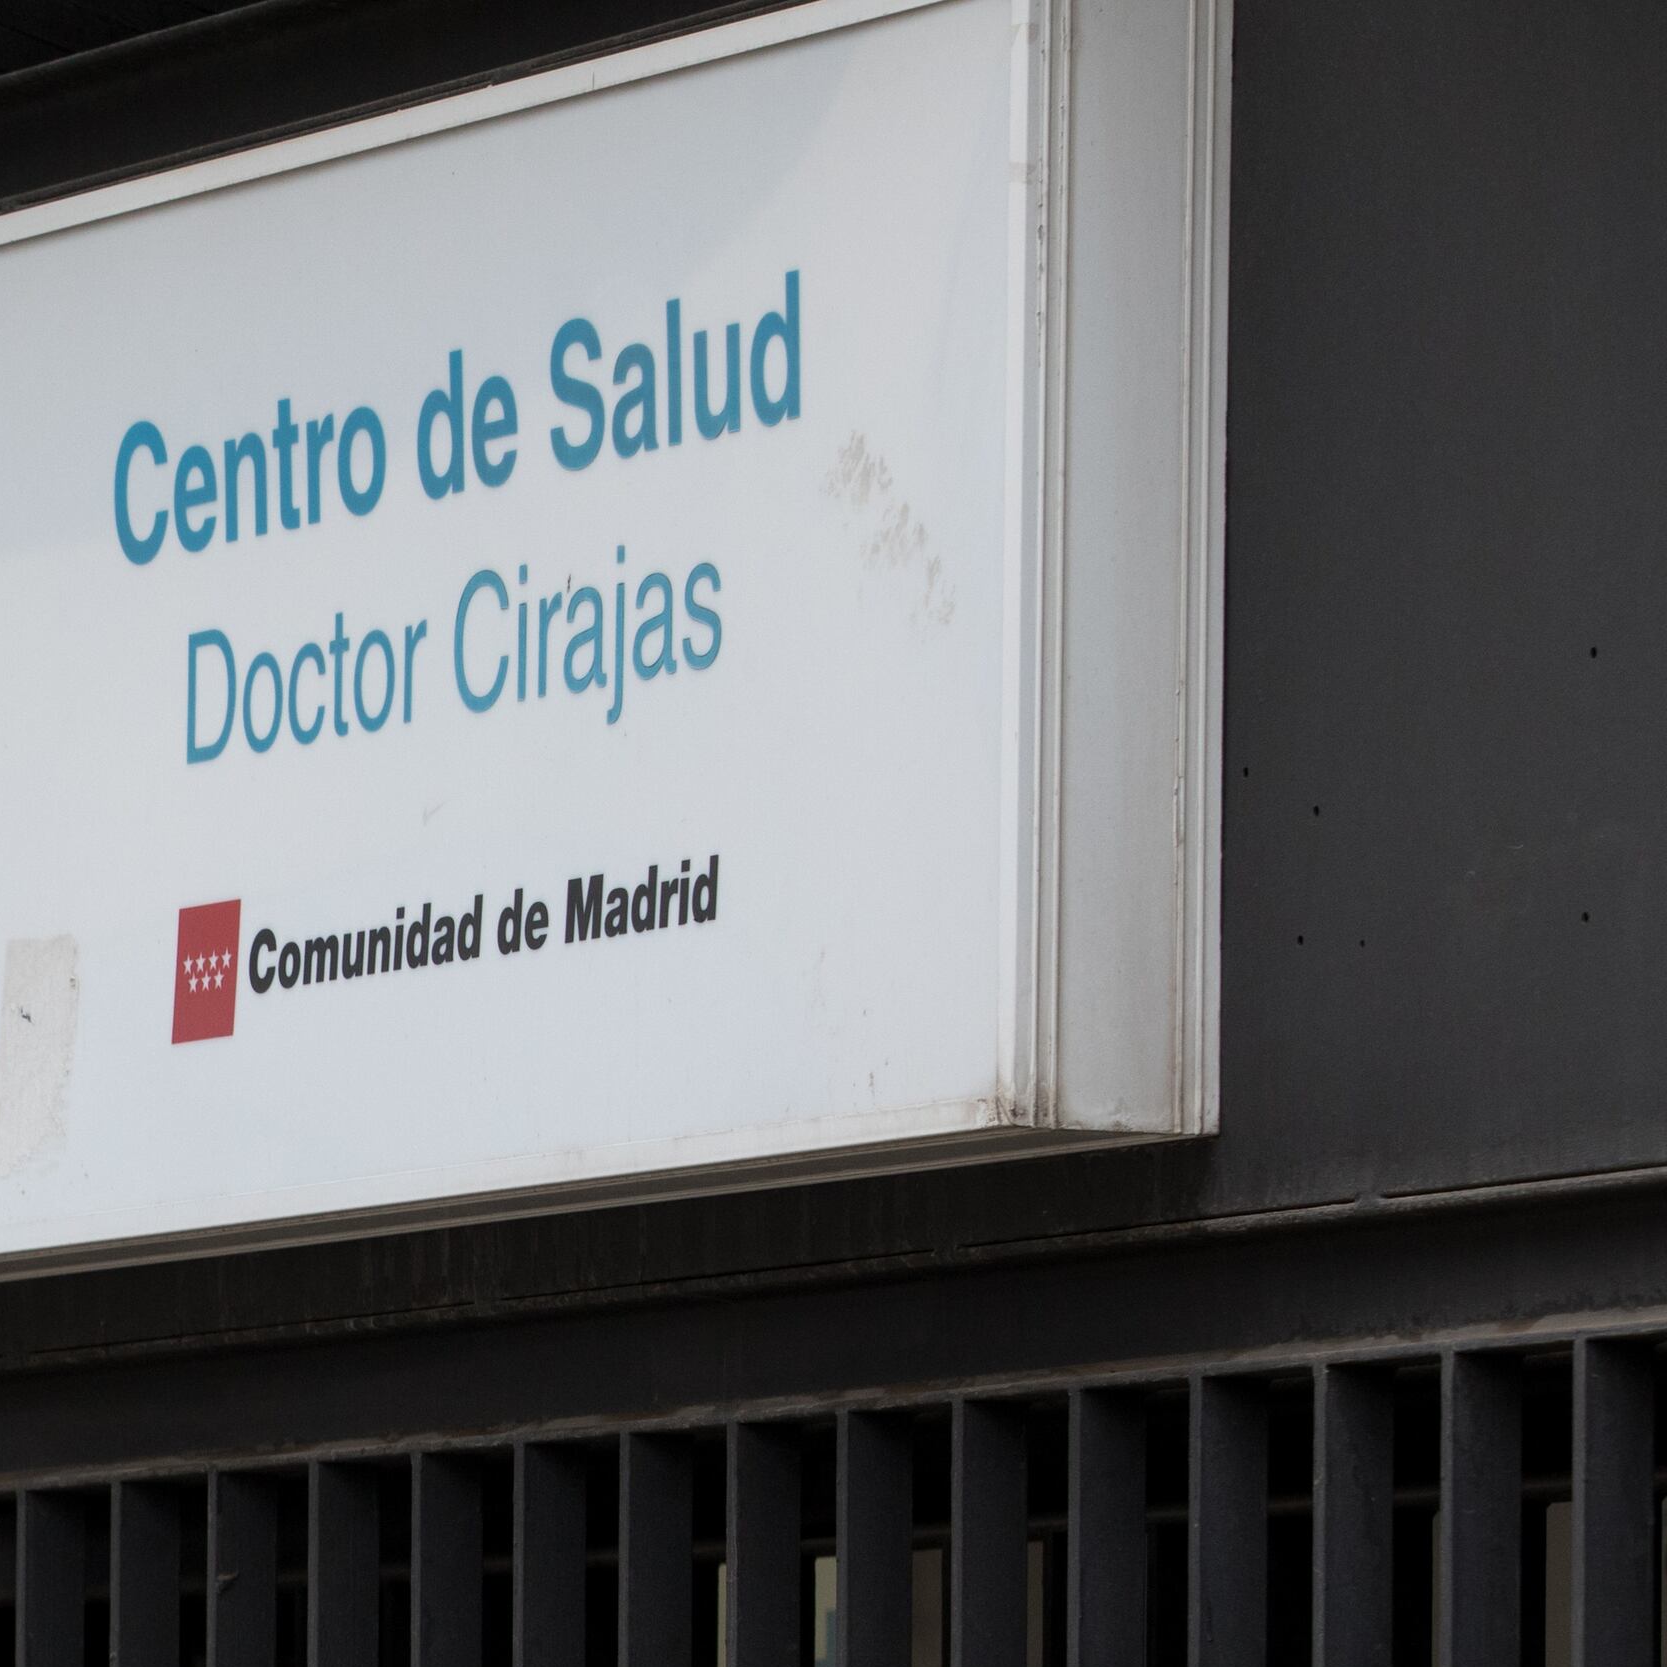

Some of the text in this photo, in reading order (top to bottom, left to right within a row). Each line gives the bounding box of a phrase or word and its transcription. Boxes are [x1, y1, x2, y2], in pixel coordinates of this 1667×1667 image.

[112, 269, 801, 566] Centro de Salud
[185, 545, 722, 764] Doctor Cirajas
[247, 853, 720, 995] Comunidad de Madrid
